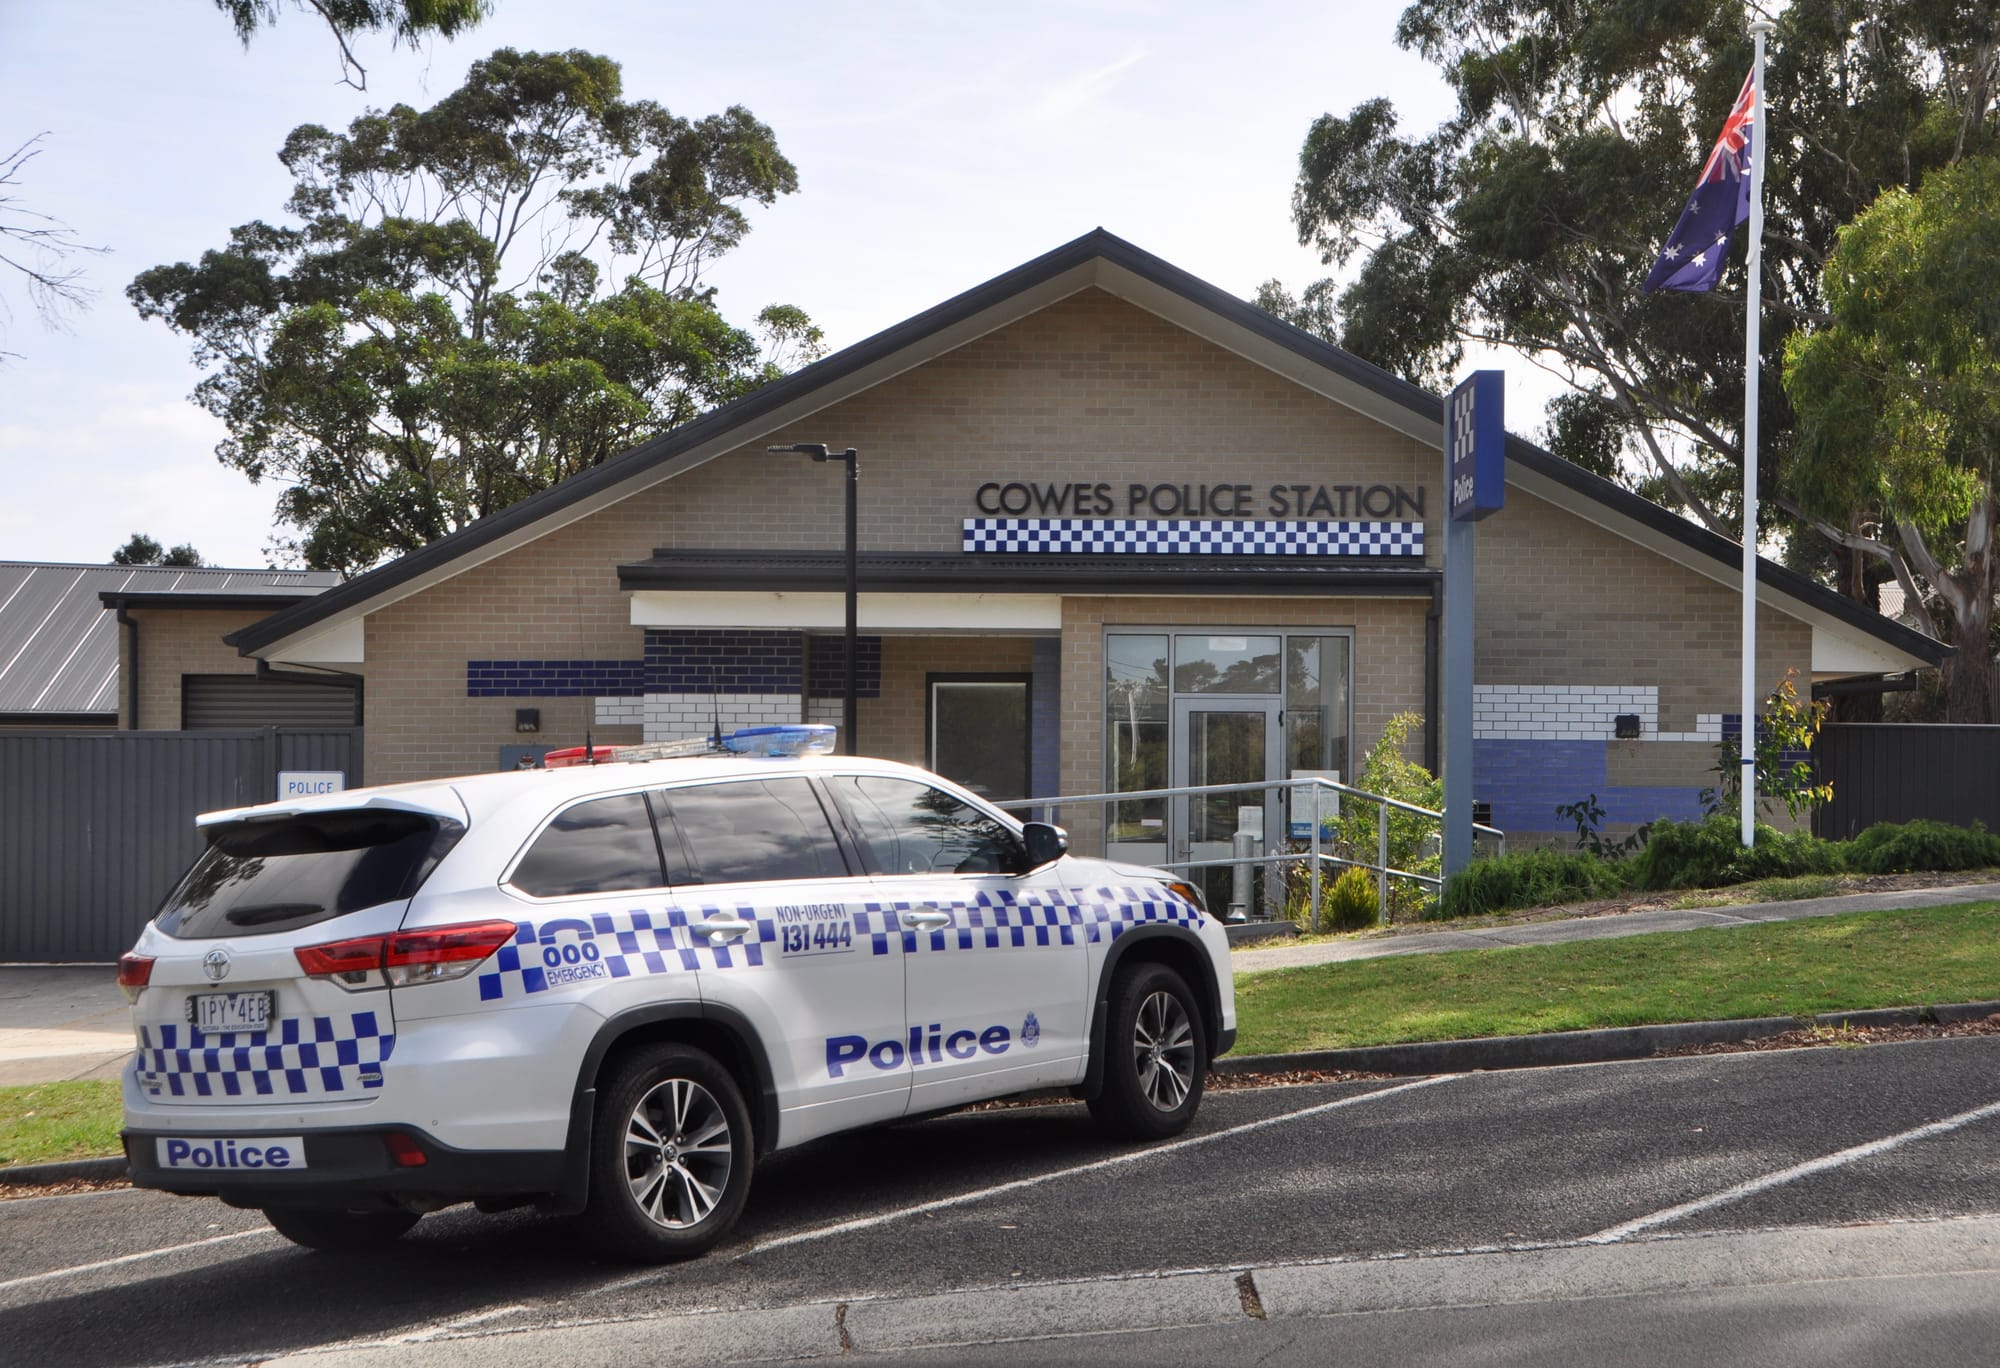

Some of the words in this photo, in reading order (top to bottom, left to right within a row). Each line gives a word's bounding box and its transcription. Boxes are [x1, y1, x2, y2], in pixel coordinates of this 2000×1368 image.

[976, 482, 1114, 516] COWES
[1129, 483, 1253, 517] POLICE
[1268, 484, 1425, 518] STATION
[1454, 473, 1473, 507] Police
[289, 782, 333, 793] POLICE
[776, 903, 847, 923] NON-URGENT
[781, 924, 810, 952] 131
[813, 921, 852, 949] 444
[547, 963, 606, 985] EMERGENCY
[826, 1023, 1011, 1078] Police
[167, 1139, 290, 1168] Police
